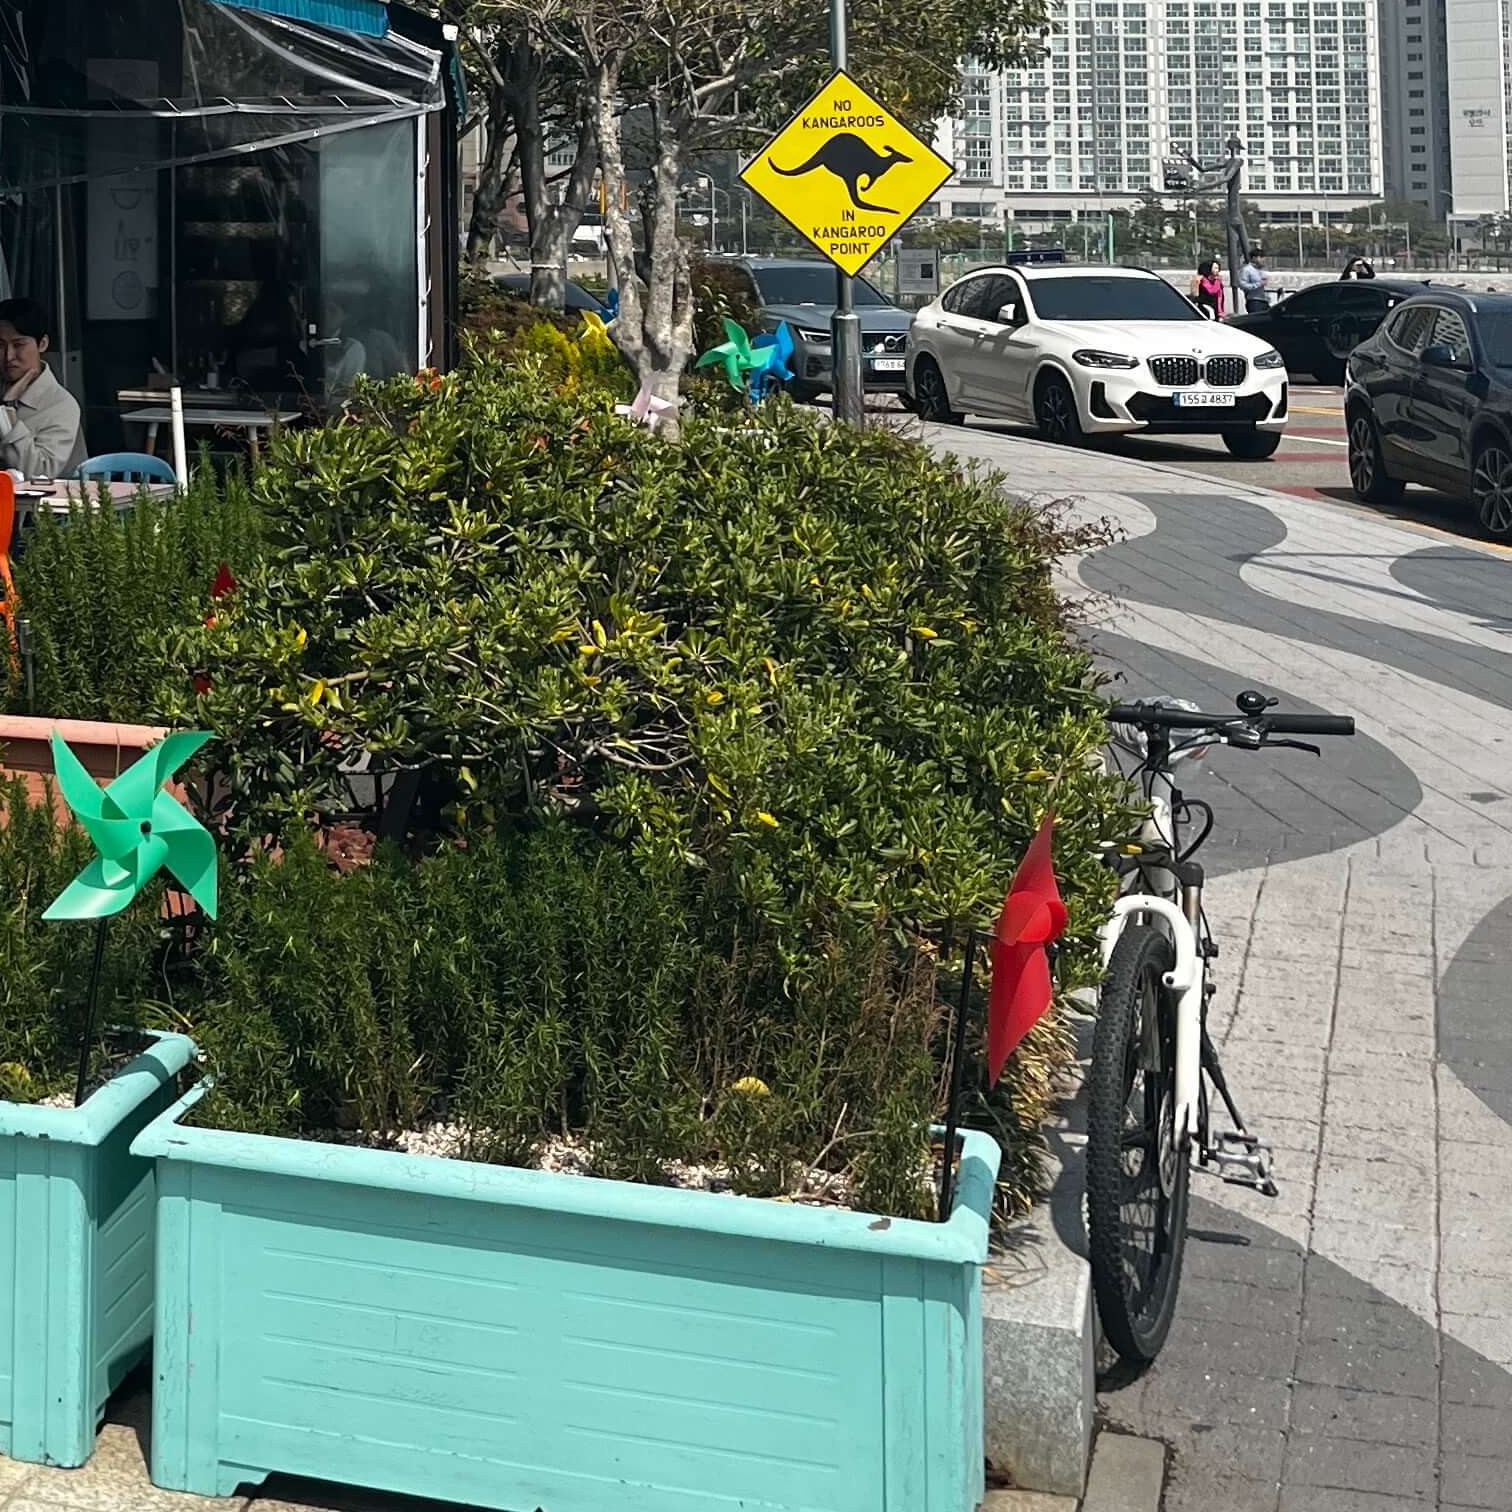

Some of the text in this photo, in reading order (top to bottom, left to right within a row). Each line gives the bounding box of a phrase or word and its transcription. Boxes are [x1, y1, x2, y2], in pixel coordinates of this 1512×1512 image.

[834, 100, 851, 112] NO
[802, 115, 885, 129] KANGAROOS
[842, 210, 854, 222] IN
[813, 226, 886, 238] KANGAROO
[830, 243, 870, 255] POINT
